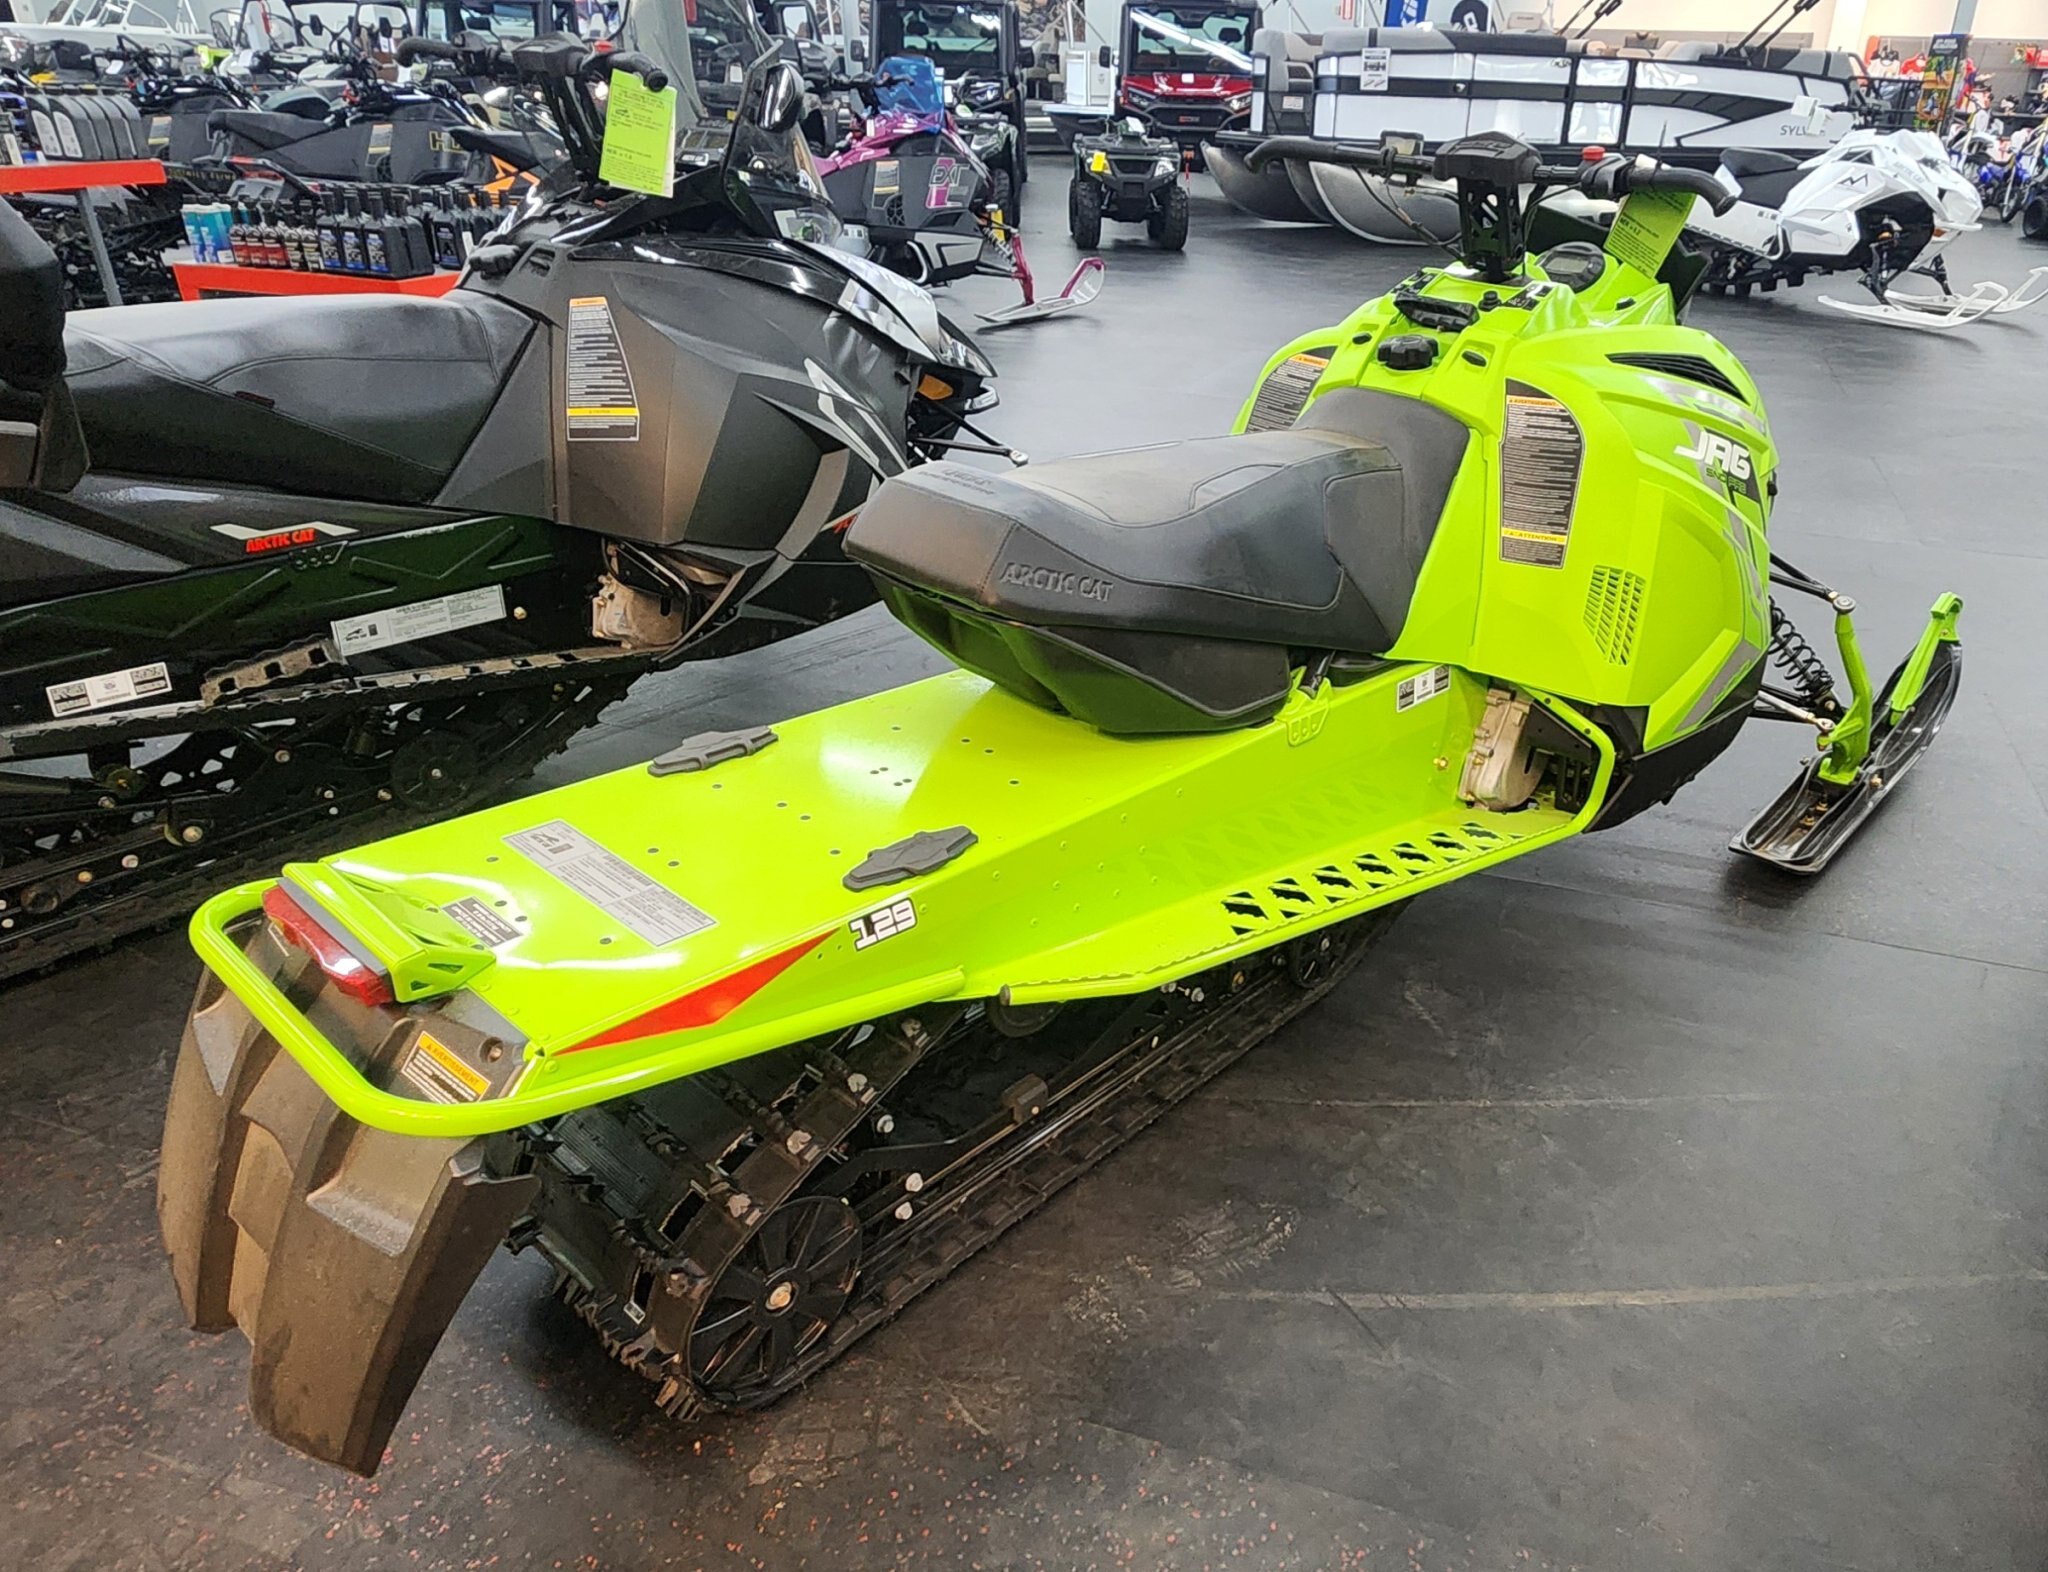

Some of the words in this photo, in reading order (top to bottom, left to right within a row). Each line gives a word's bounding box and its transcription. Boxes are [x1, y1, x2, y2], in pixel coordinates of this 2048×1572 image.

[1673, 431, 1751, 480] JAG
[245, 533, 290, 553] ARCTIC
[291, 527, 316, 546] CAT
[1518, 532, 1557, 542] ATTENTION
[1000, 561, 1075, 595] ARCTIC
[1078, 576, 1114, 602] CAT
[849, 898, 917, 951] 129
